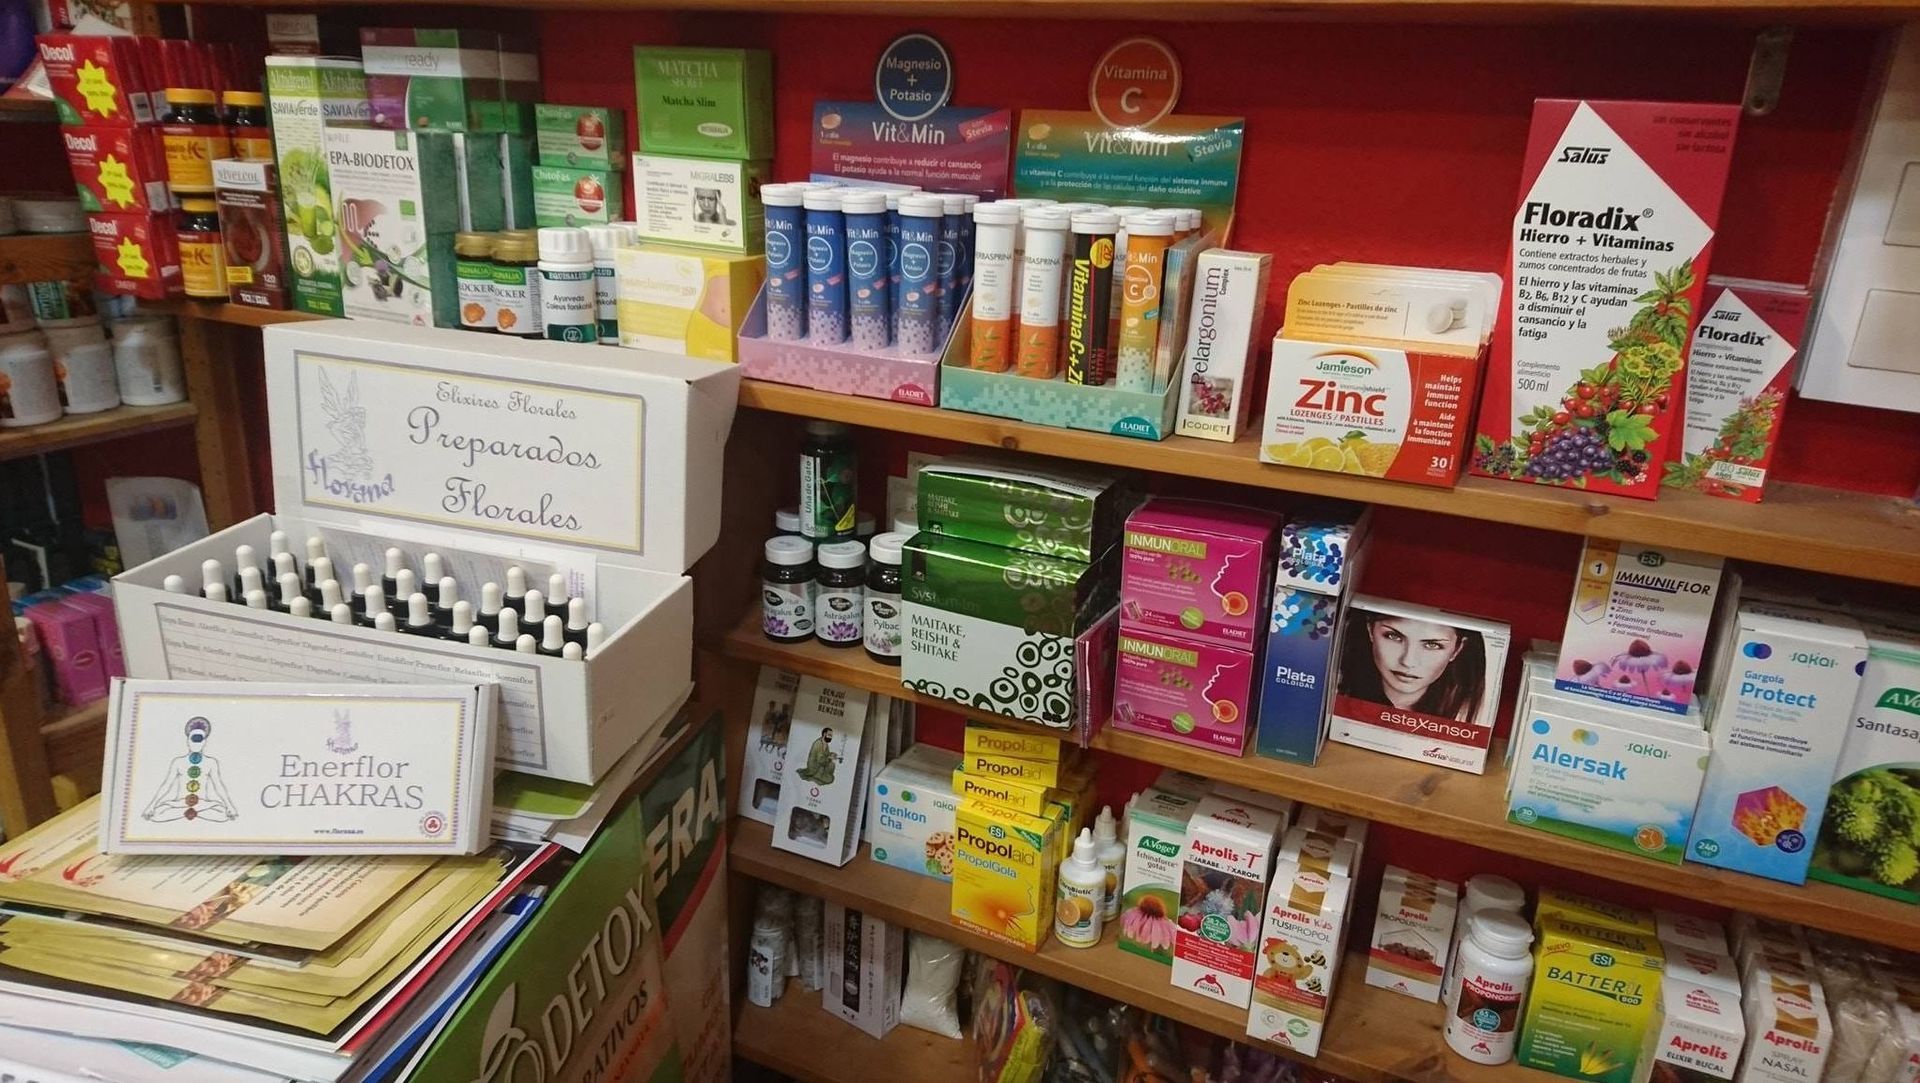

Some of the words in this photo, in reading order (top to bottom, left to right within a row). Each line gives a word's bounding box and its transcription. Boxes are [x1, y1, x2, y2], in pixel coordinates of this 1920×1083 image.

[886, 57, 942, 71] Magnesio
[1104, 65, 1168, 80] Vitamina
[907, 74, 918, 87] +
[890, 88, 932, 102] Potasio
[1121, 87, 1142, 114] C
[872, 120, 946, 145] Vit&Min
[1193, 137, 1233, 158] Stevia
[1557, 147, 1611, 164] Salus
[329, 150, 415, 171] EPA-BIODETOX
[1519, 228, 1570, 244] Hierro
[1575, 235, 1588, 245] +
[1593, 233, 1675, 253] Vitaminas
[1518, 248, 1558, 260] Contiene
[1559, 252, 1600, 263] extractos
[1601, 253, 1639, 265] herbales
[1518, 261, 1547, 270] zumos
[1548, 262, 1606, 275] concentrados
[1607, 266, 1620, 275] de
[1621, 266, 1648, 278] frutas
[1219, 268, 1230, 296] Complex
[1518, 277, 1528, 286] El
[1530, 276, 1561, 289] hierro
[1571, 279, 1587, 291] las
[1588, 282, 1639, 296] vitaminas
[1518, 289, 1533, 301] B2,
[1552, 291, 1569, 304] B12
[1590, 296, 1629, 308] ayudan
[1527, 302, 1573, 316] disminuir
[1576, 306, 1586, 316] el
[1711, 309, 1742, 322] Salus
[1190, 266, 1222, 386] Pelargonium
[1518, 314, 1566, 328] cansancio
[1577, 318, 1588, 329] la
[1518, 326, 1548, 341] fatiga
[1316, 360, 1372, 376] Jamieson
[1425, 382, 1460, 392] maintain
[1440, 374, 1462, 384] Helps
[1517, 378, 1536, 391] 500
[1536, 380, 1550, 392] ml
[435, 381, 500, 411] Elixires
[506, 389, 578, 421] Florales
[1295, 379, 1388, 418] Zinc
[1424, 399, 1457, 409] function
[1427, 391, 1459, 400] immune
[1290, 408, 1332, 421] LOZENGES
[1340, 414, 1384, 426] PASTILLES
[1419, 420, 1454, 430] maintenir
[1439, 412, 1456, 421] Aide
[406, 405, 602, 470] Preparados
[1407, 435, 1452, 447] immunitaire
[1422, 428, 1453, 438] fonction
[1431, 456, 1448, 468] 30
[440, 475, 584, 532] Florales
[1129, 534, 1207, 556] INMUNORAL
[1292, 547, 1327, 564] Plata
[1640, 554, 1662, 567] ESI
[1595, 562, 1604, 575] 1
[1615, 571, 1711, 596] IMMUNILFLOR
[911, 613, 967, 639] MAITAKE,
[1614, 614, 1648, 625] Vitamina
[911, 626, 949, 646] REISHI
[951, 638, 961, 650] &
[910, 640, 959, 662] SHITAKE
[1122, 639, 1198, 663] INMUNORAL
[1275, 676, 1315, 690] COLOIDAL
[1276, 666, 1316, 685] Plata
[1740, 682, 1817, 709] Protect
[977, 735, 1046, 754] Propolaid
[279, 753, 411, 782] Enerflor
[976, 758, 1042, 781] Propolaid
[1532, 743, 1629, 781] Alersak
[260, 782, 425, 811] CHAKRAS
[964, 780, 1027, 808] Propolaid
[880, 802, 928, 824] Renkon
[879, 815, 903, 831] Cha
[989, 826, 1005, 838] ESI
[957, 827, 1037, 867] Propolaid
[1191, 839, 1239, 863] Aprolis
[957, 848, 1018, 879] PropolGola
[1146, 861, 1167, 872] gotas
[1272, 905, 1310, 925] Aprolis
[1399, 908, 1429, 923] Aprolis
[1592, 953, 1613, 966] ESI
[1474, 975, 1514, 992] Aprolis
[1669, 1035, 1729, 1061] Aprolis
[1763, 1030, 1822, 1055] Aprolis
[1666, 1051, 1694, 1065] ELIXIR
[1696, 1058, 1726, 1074] BUCAL
[1760, 1056, 1809, 1078] NASAL
